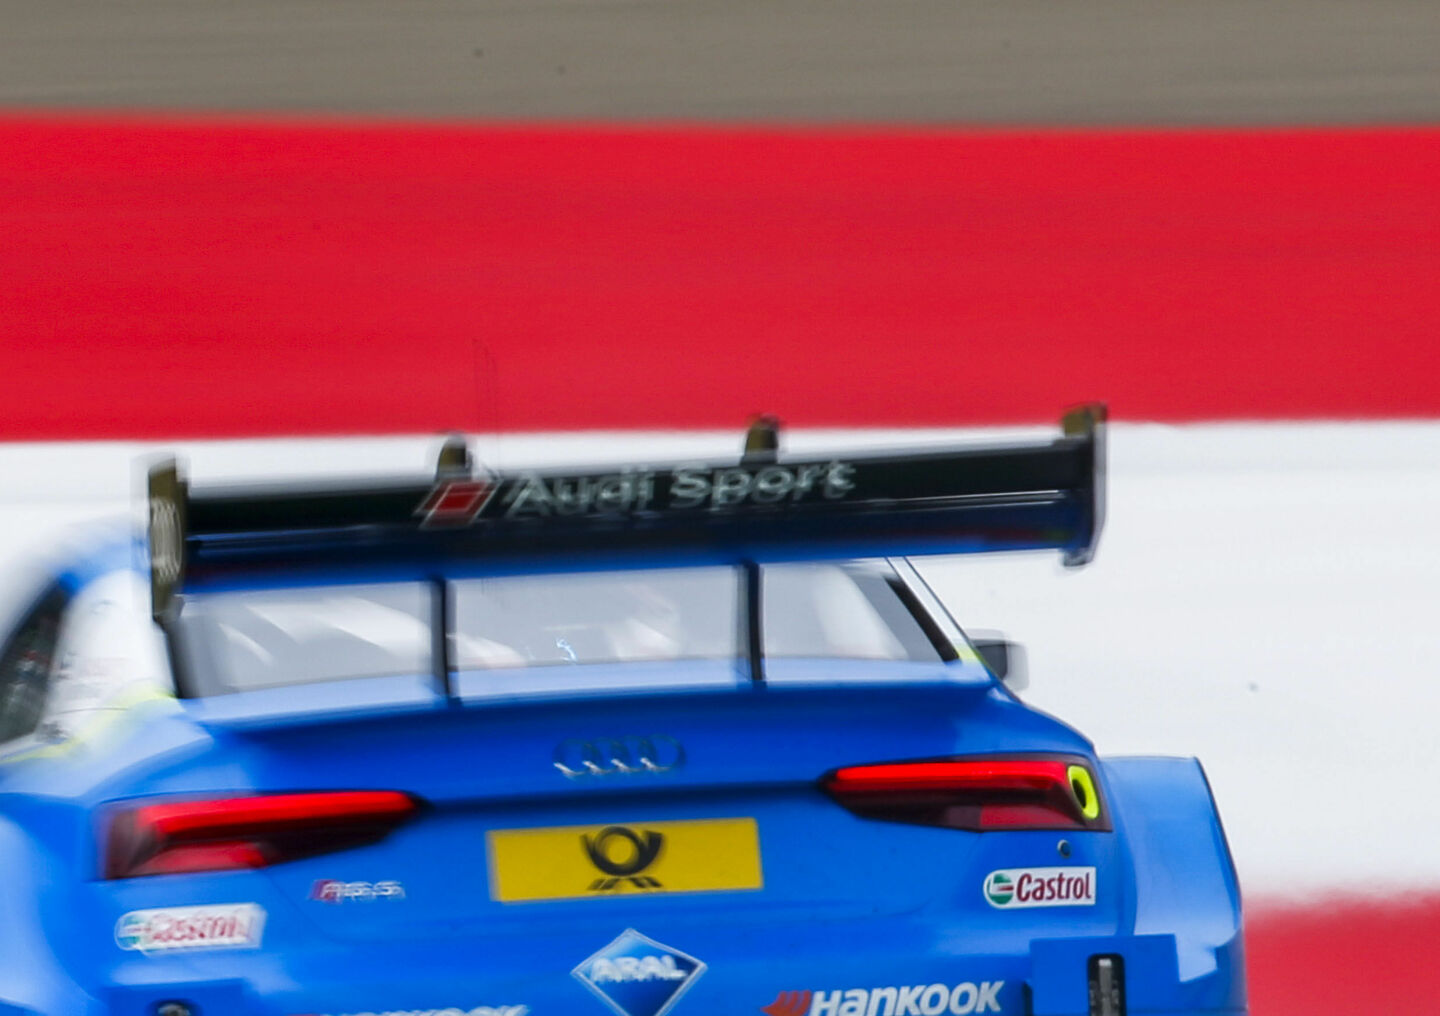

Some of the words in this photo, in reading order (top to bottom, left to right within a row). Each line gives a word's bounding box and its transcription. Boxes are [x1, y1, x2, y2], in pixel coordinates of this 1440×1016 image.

[507, 464, 656, 519] Audi
[669, 460, 855, 512] Sport
[1016, 872, 1092, 902] Castrol
[592, 955, 687, 982] ARAL
